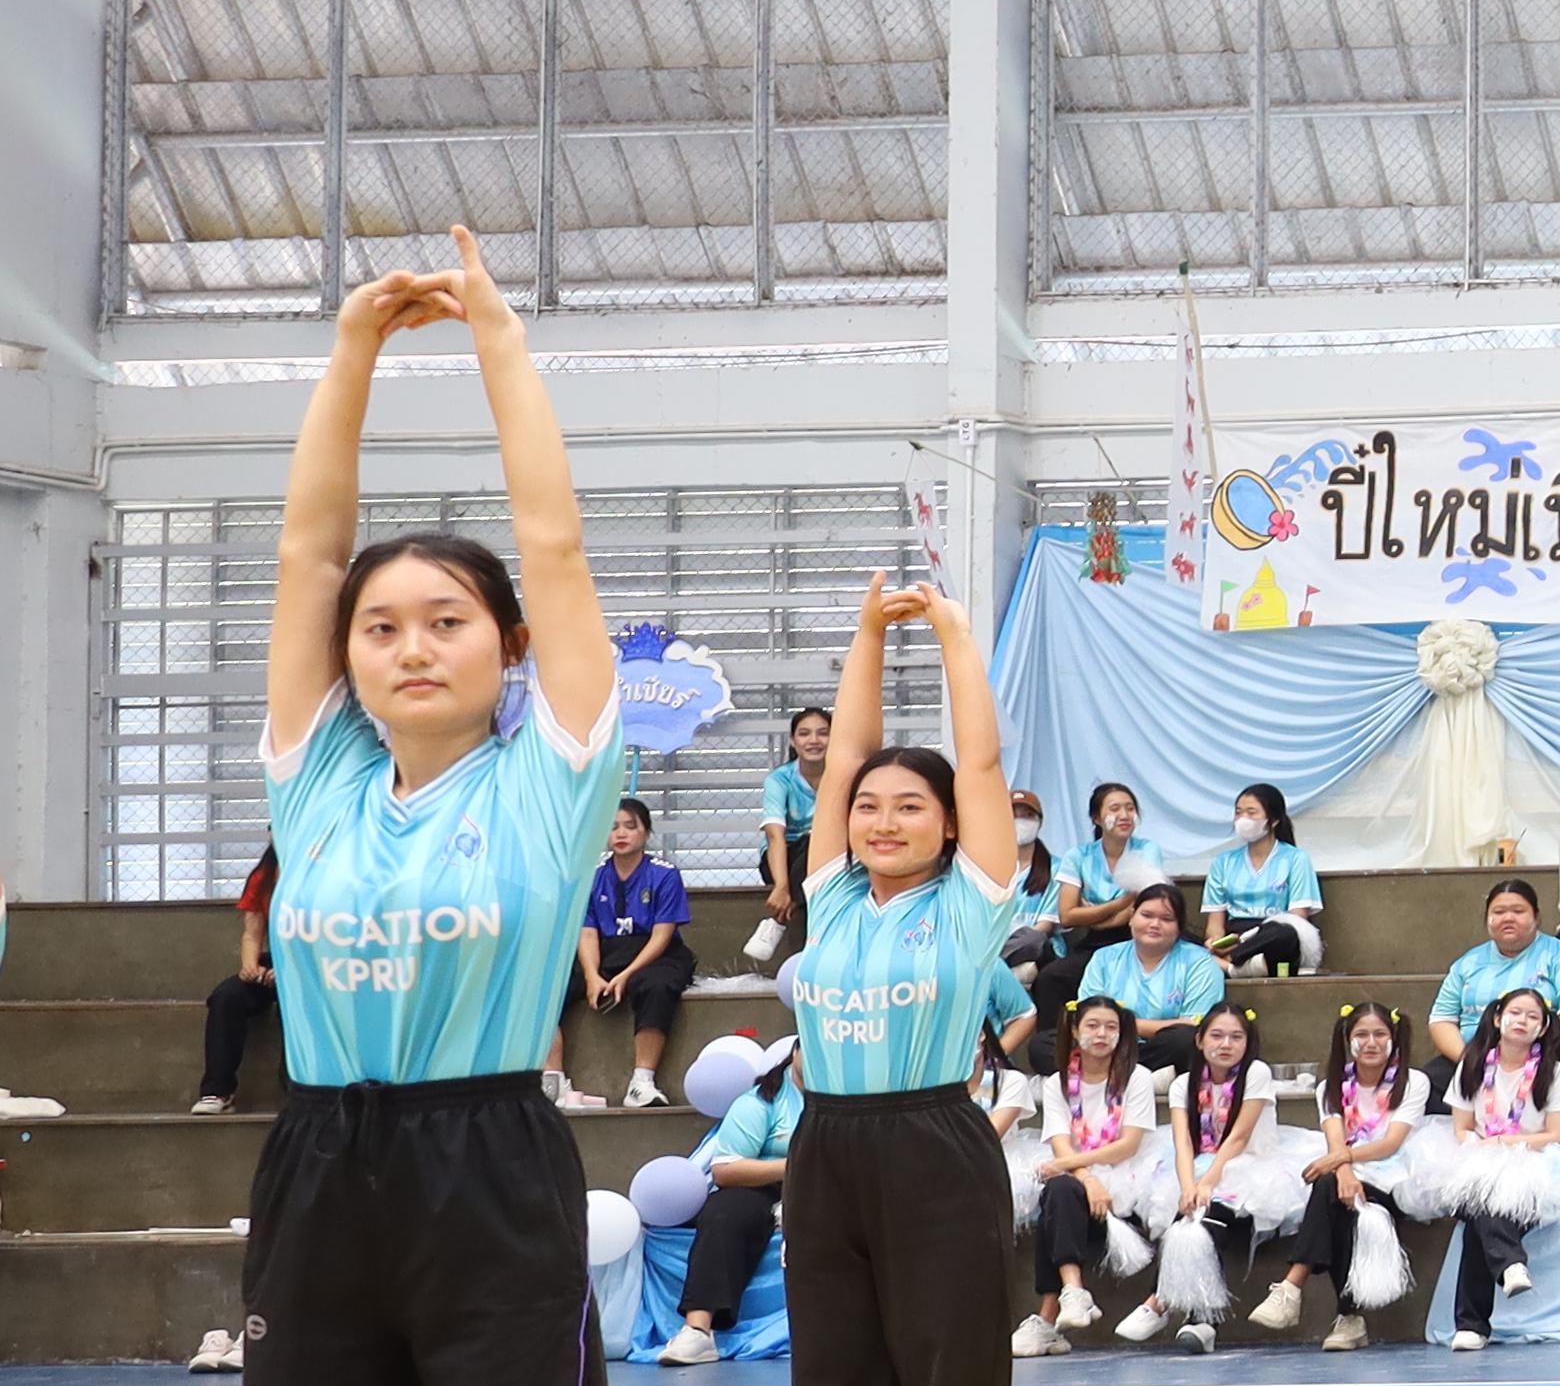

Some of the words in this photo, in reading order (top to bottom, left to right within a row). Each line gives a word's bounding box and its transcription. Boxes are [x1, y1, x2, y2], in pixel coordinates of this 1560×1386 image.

[277, 902, 500, 948] DUCATION
[320, 956, 417, 993] KPRU
[793, 975, 938, 1014] DUCATION
[823, 1016, 885, 1045] KPRU
